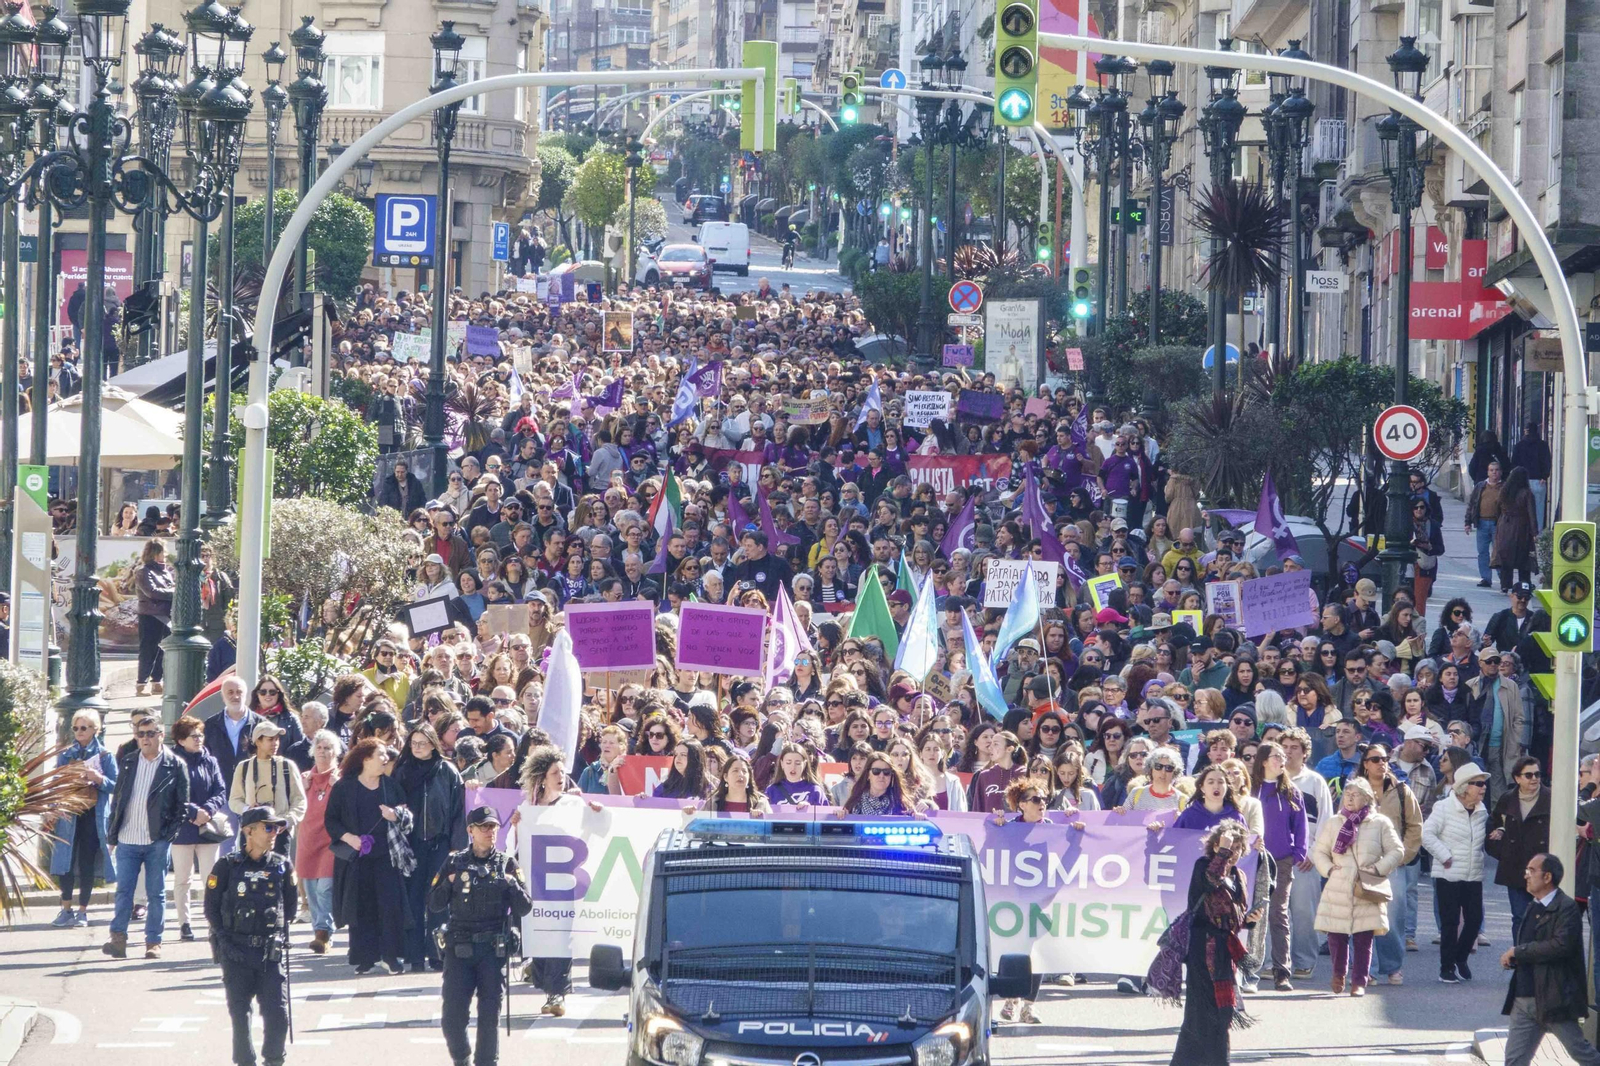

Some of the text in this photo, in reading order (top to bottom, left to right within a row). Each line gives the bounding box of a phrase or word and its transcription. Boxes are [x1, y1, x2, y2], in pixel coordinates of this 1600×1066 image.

[392, 203, 420, 236] P
[1311, 274, 1339, 286] hoss
[1411, 304, 1462, 318] arenal
[1001, 321, 1031, 341] Moda
[1386, 423, 1417, 441] 40
[988, 564, 1049, 581] PATRIAADO
[613, 613, 650, 621] PROTESTO
[688, 612, 714, 621] SOMOS
[579, 626, 604, 635] PORQUE
[685, 643, 756, 656] NO TIENEN VOZ
[530, 834, 650, 903] BA
[1148, 846, 1178, 892] É
[532, 908, 576, 921] Bloque
[603, 926, 632, 939] Vigo
[738, 1021, 876, 1037] POLICÍA
